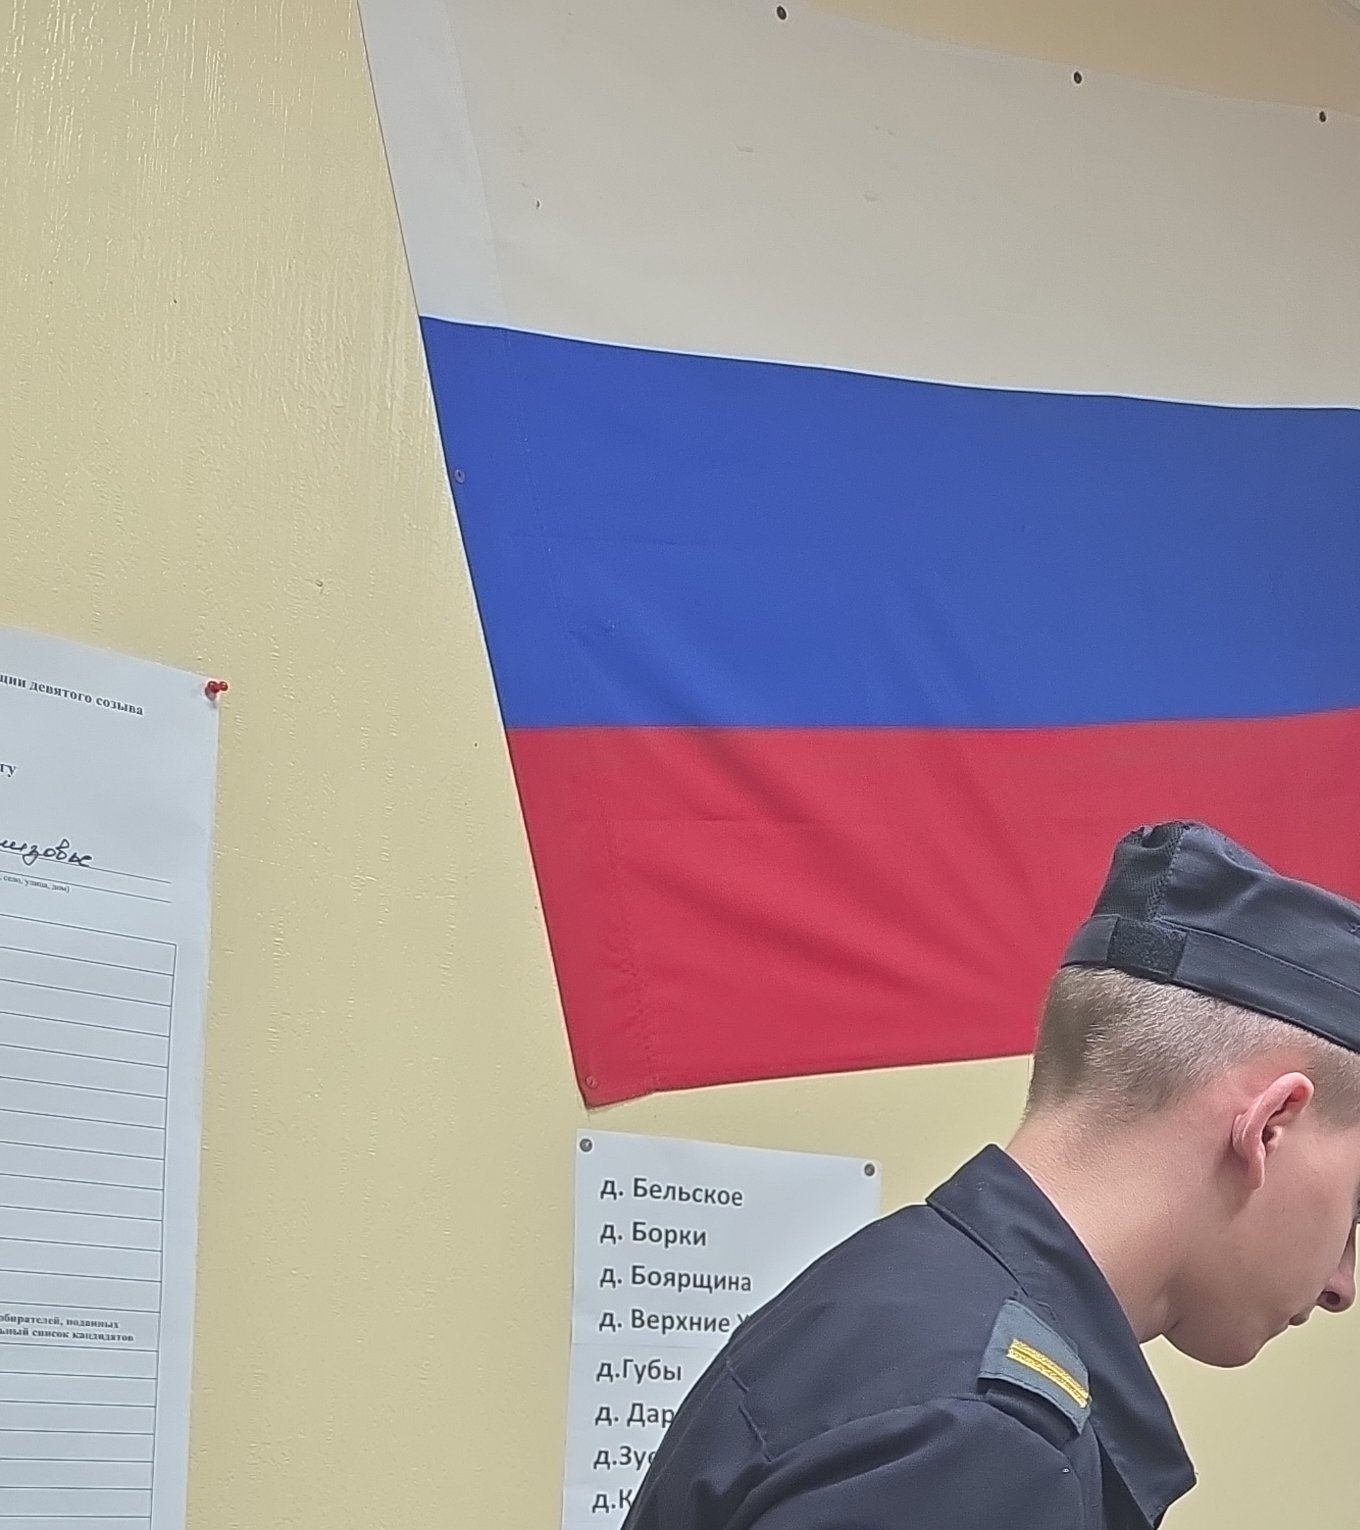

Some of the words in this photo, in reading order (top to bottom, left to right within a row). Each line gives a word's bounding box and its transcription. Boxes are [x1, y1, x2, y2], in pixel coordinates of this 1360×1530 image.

[29, 680, 92, 704] девятого
[96, 697, 144, 716] созыва
[600, 1179, 624, 1201] д.
[633, 1177, 743, 1206] Бельское
[600, 1224, 623, 1245] д.
[632, 1221, 707, 1249] Борки
[600, 1268, 622, 1289] д.
[631, 1265, 752, 1294] Боярщина
[599, 1312, 622, 1333] д.
[631, 1308, 731, 1335] Верхние
[32, 1329, 69, 1339] список
[72, 1330, 134, 1342] кандидатов
[596, 1358, 682, 1385] д.Губы
[595, 1406, 619, 1427] д.
